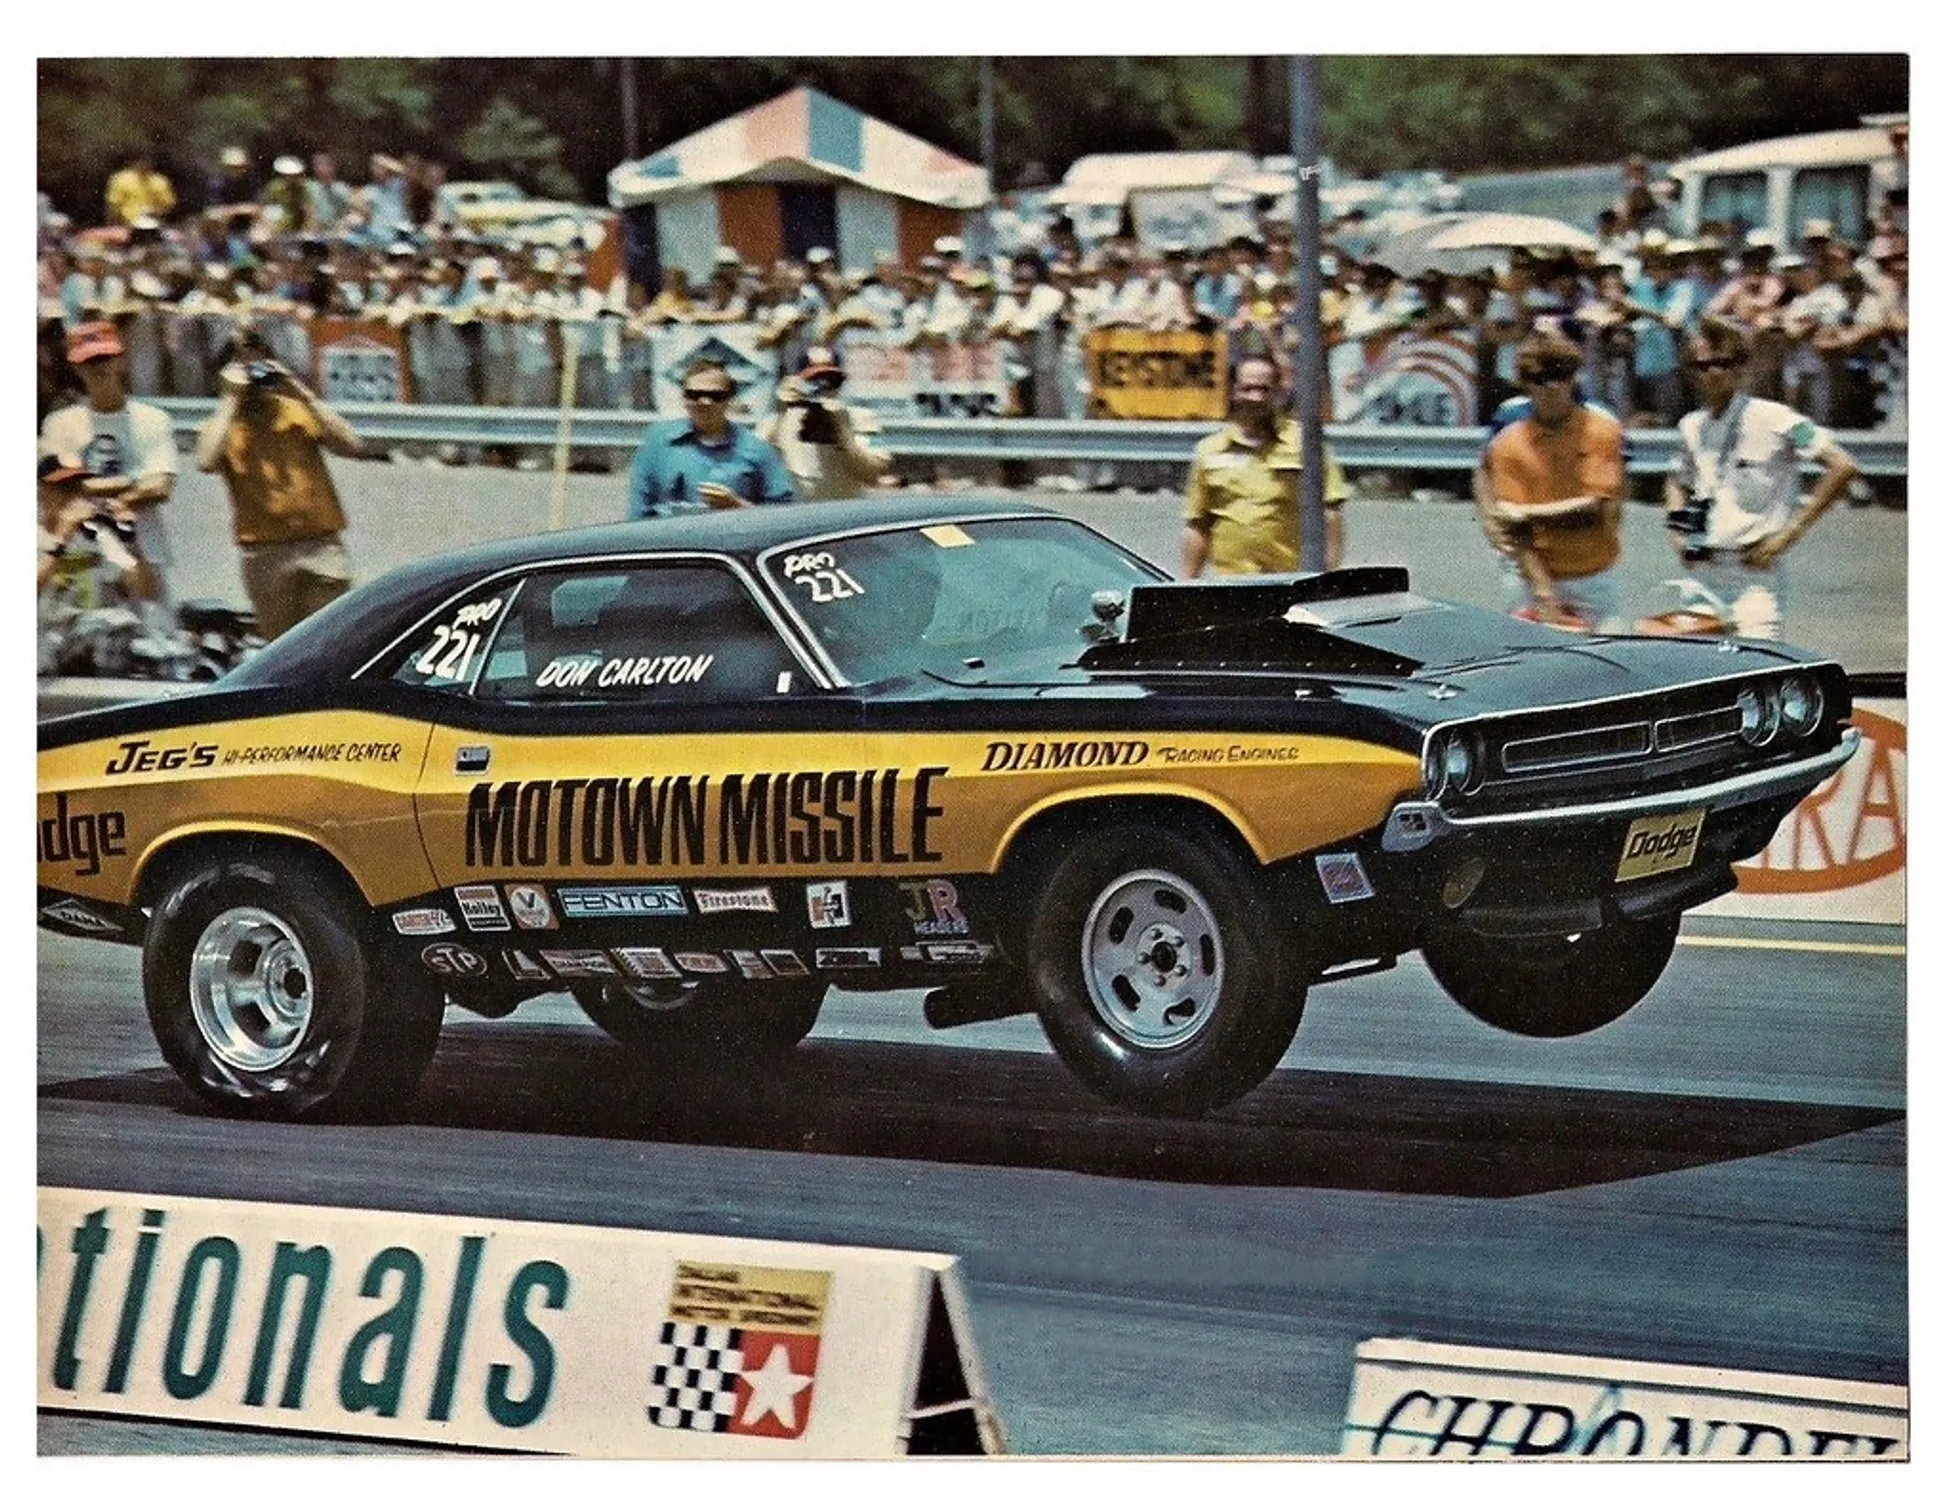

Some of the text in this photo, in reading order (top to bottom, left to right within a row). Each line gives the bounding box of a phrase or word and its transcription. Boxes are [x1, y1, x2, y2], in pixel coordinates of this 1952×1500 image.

[783, 552, 835, 578] PRO
[794, 568, 865, 602] 221
[452, 598, 503, 630] PRO
[415, 624, 480, 680] 221
[535, 654, 714, 688] DON CARLTON
[105, 740, 403, 776] JEG'S HI-PERFORMANCE CENTER
[980, 740, 1149, 771] DIAMOND
[1156, 746, 1226, 764] RACING
[464, 766, 950, 868] MOTOWN MISSILE
[37, 792, 128, 877] dge
[1625, 823, 1699, 860] Dodge
[563, 891, 685, 911] FENTON
[431, 947, 479, 974] STP
[37, 1206, 569, 1429] tionals
